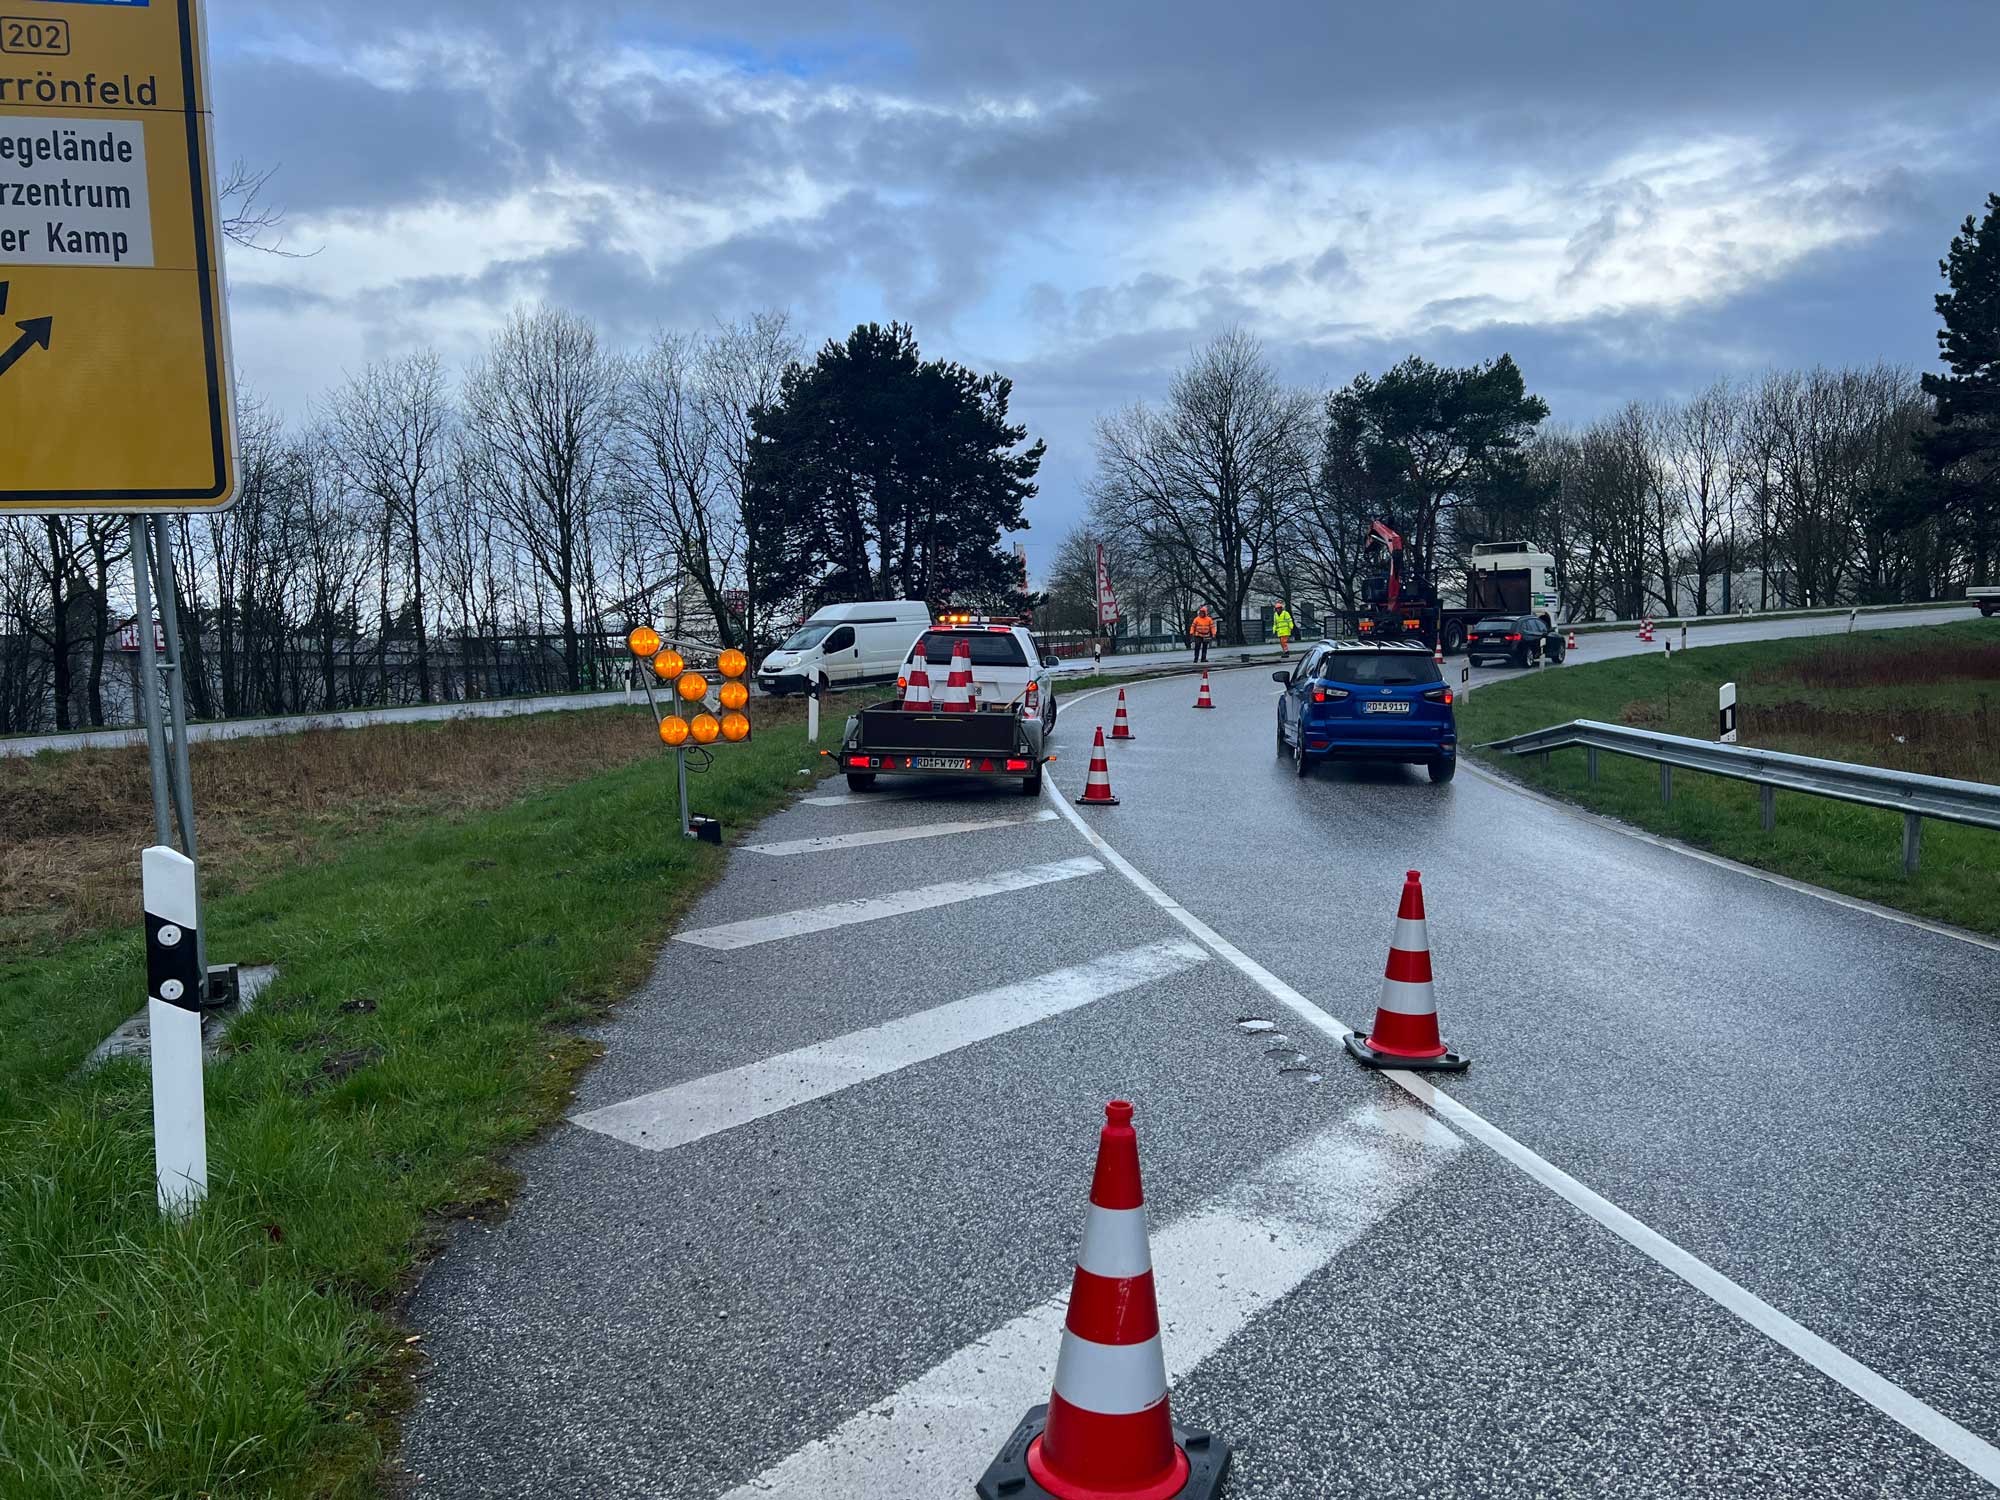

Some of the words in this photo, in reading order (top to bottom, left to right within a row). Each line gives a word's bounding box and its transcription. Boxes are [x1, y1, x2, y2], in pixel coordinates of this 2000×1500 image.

[7, 23, 62, 49] 202
[0, 71, 157, 106] rrönfeld
[0, 130, 133, 168] egelände
[0, 178, 131, 209] rzentrum
[0, 229, 30, 252] er
[46, 222, 128, 262] Kamp
